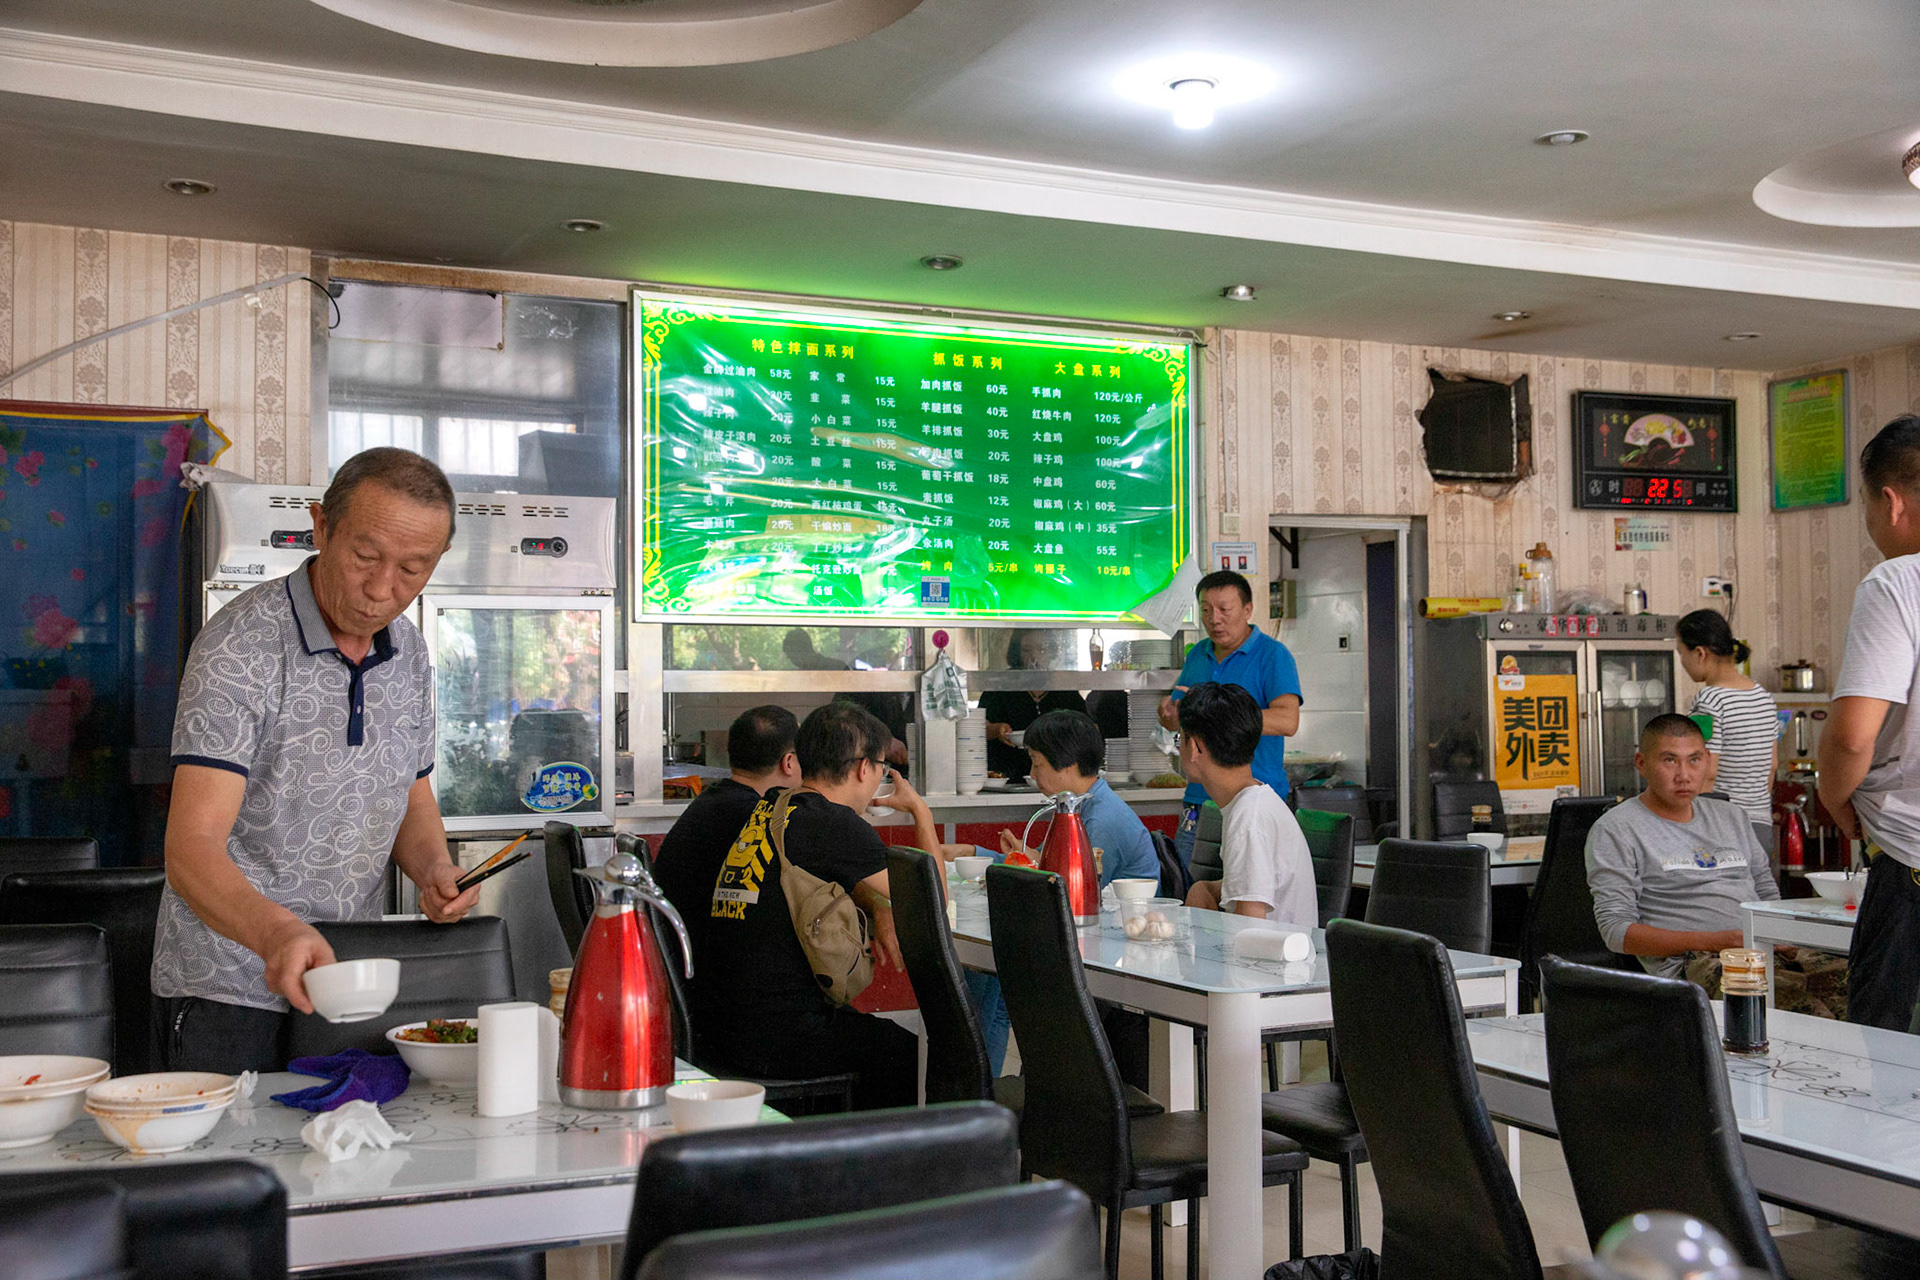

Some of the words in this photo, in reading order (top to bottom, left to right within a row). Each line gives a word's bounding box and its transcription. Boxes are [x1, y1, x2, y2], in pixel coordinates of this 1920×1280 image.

[933, 352, 1002, 370] 抓饭系列
[769, 368, 792, 380] 58元
[1055, 361, 1121, 379] 大盘系列
[810, 371, 846, 383] 家常
[875, 376, 896, 387] 15元
[920, 378, 963, 392] 加肉抓饭
[986, 384, 1009, 396] 60元
[810, 392, 851, 404] 韭菜
[875, 397, 896, 408] 15元
[1031, 386, 1062, 399] 手抓肉
[1094, 391, 1144, 404] 120元/公斤
[921, 401, 963, 415] 羊腿抓饭
[986, 406, 1009, 418] 40元
[1032, 409, 1072, 422] 红烧牛肉
[1094, 413, 1121, 424] 120元
[770, 412, 793, 425] 20元
[811, 413, 852, 426] 小白菜
[876, 418, 897, 429] 15元
[770, 433, 792, 444] 20元
[921, 424, 963, 437] 羊排抓饭
[987, 428, 1010, 440] 30元
[1032, 431, 1063, 443] 大盘鸡
[1095, 435, 1122, 446] 100元
[810, 435, 852, 447] 土豆丝
[875, 437, 897, 449] 15元
[772, 455, 794, 466] 20元
[811, 457, 852, 469] 酸菜
[876, 460, 897, 471] 15元
[988, 451, 1010, 462] 20元
[1033, 453, 1063, 466] 辣子鸡
[1095, 457, 1122, 468] 100元
[772, 476, 795, 488] 20元
[812, 477, 853, 490] 大白菜
[877, 481, 898, 492] 15元
[921, 469, 974, 482] 葡萄干抓饭
[987, 473, 1009, 485] 18元
[1033, 475, 1063, 488] 中盘鸡
[1095, 479, 1117, 490] 60元
[771, 498, 794, 509] 20元
[923, 492, 954, 504] 素抓饭
[987, 495, 1010, 507] 12元
[1095, 501, 1117, 512] 60元
[771, 519, 794, 531] 20元
[921, 514, 954, 527] 丸子汤
[988, 518, 1011, 529] 20元
[1096, 523, 1118, 534] 35元
[987, 540, 1010, 551] 20元
[1033, 543, 1064, 555] 大盘鱼
[1096, 545, 1117, 556] 55元
[921, 560, 953, 572] 烤肉
[987, 562, 1018, 574] 5元/串
[1097, 565, 1131, 576] 10元/串
[813, 584, 834, 597] 汤饭
[1503, 697, 1569, 731] 美团
[1506, 732, 1572, 781] 外卖
